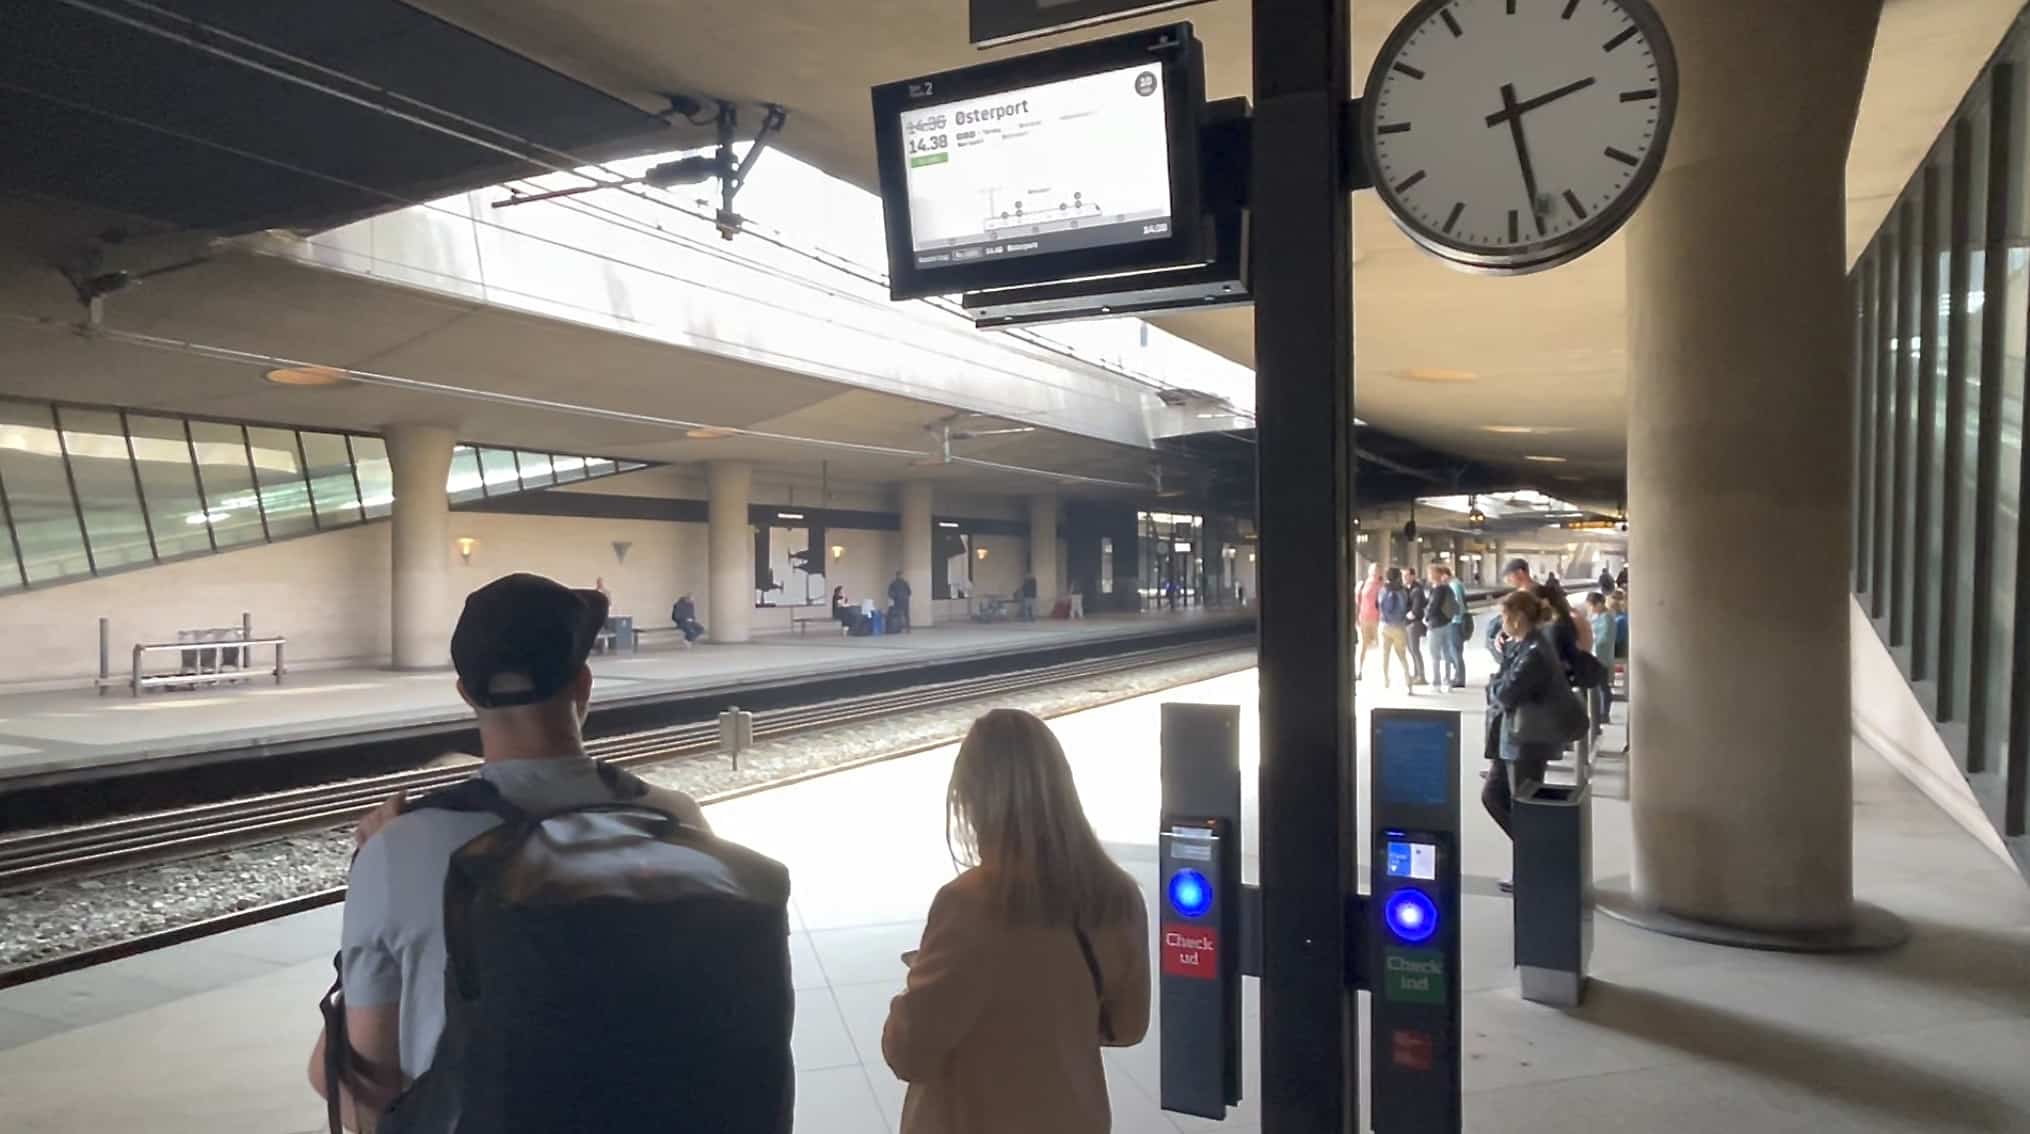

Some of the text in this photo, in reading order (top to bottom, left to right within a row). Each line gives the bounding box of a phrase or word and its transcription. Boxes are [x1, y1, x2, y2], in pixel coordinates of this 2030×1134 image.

[924, 81, 934, 96] 2
[955, 99, 1029, 126] Østerport
[909, 134, 948, 154] 14.38
[1166, 932, 1215, 951] Check
[1179, 951, 1200, 966] ud
[1386, 955, 1443, 975] Check
